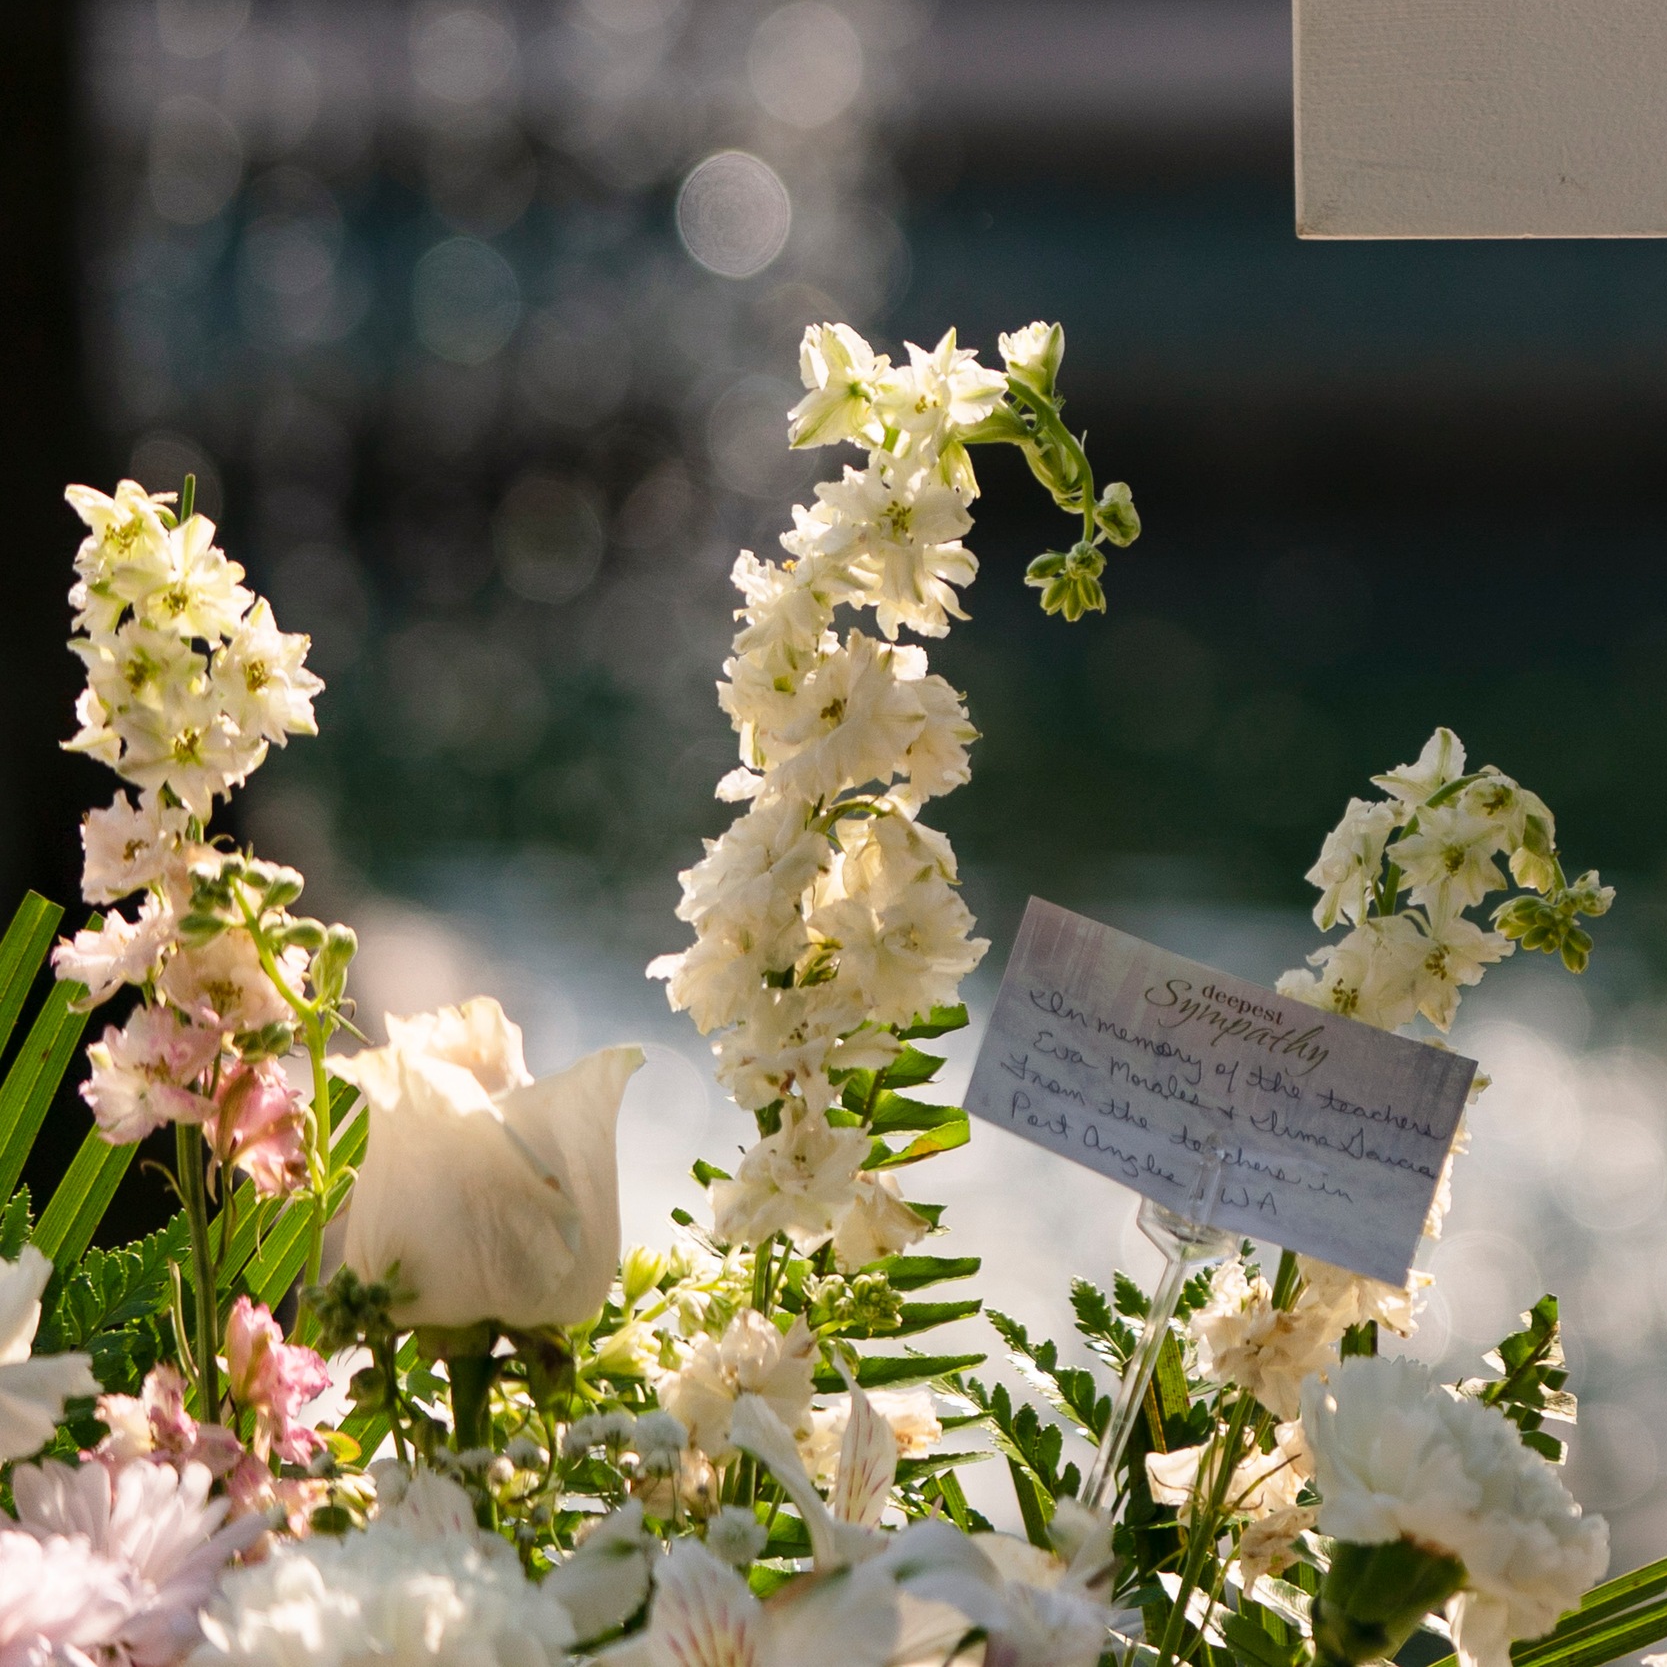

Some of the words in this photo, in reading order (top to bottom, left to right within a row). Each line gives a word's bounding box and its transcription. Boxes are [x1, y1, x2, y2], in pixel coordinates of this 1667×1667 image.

[1144, 977, 1332, 1077] Sympathy
[1201, 982, 1285, 1027] deepest
[1000, 1050, 1087, 1107] From
[1098, 1097, 1150, 1130] the
[1169, 1125, 1302, 1185] techers
[1306, 1172, 1354, 1204] in
[1032, 1031, 1099, 1070] Eva
[1109, 1055, 1213, 1112] Morales
[1249, 1109, 1337, 1148] Irma
[1096, 1017, 1203, 1085] memory
[1214, 1060, 1240, 1094] of
[1245, 1065, 1302, 1100] the
[1315, 1088, 1448, 1142] teachers
[1010, 1090, 1077, 1140] Port
[1219, 1187, 1279, 1217] WA
